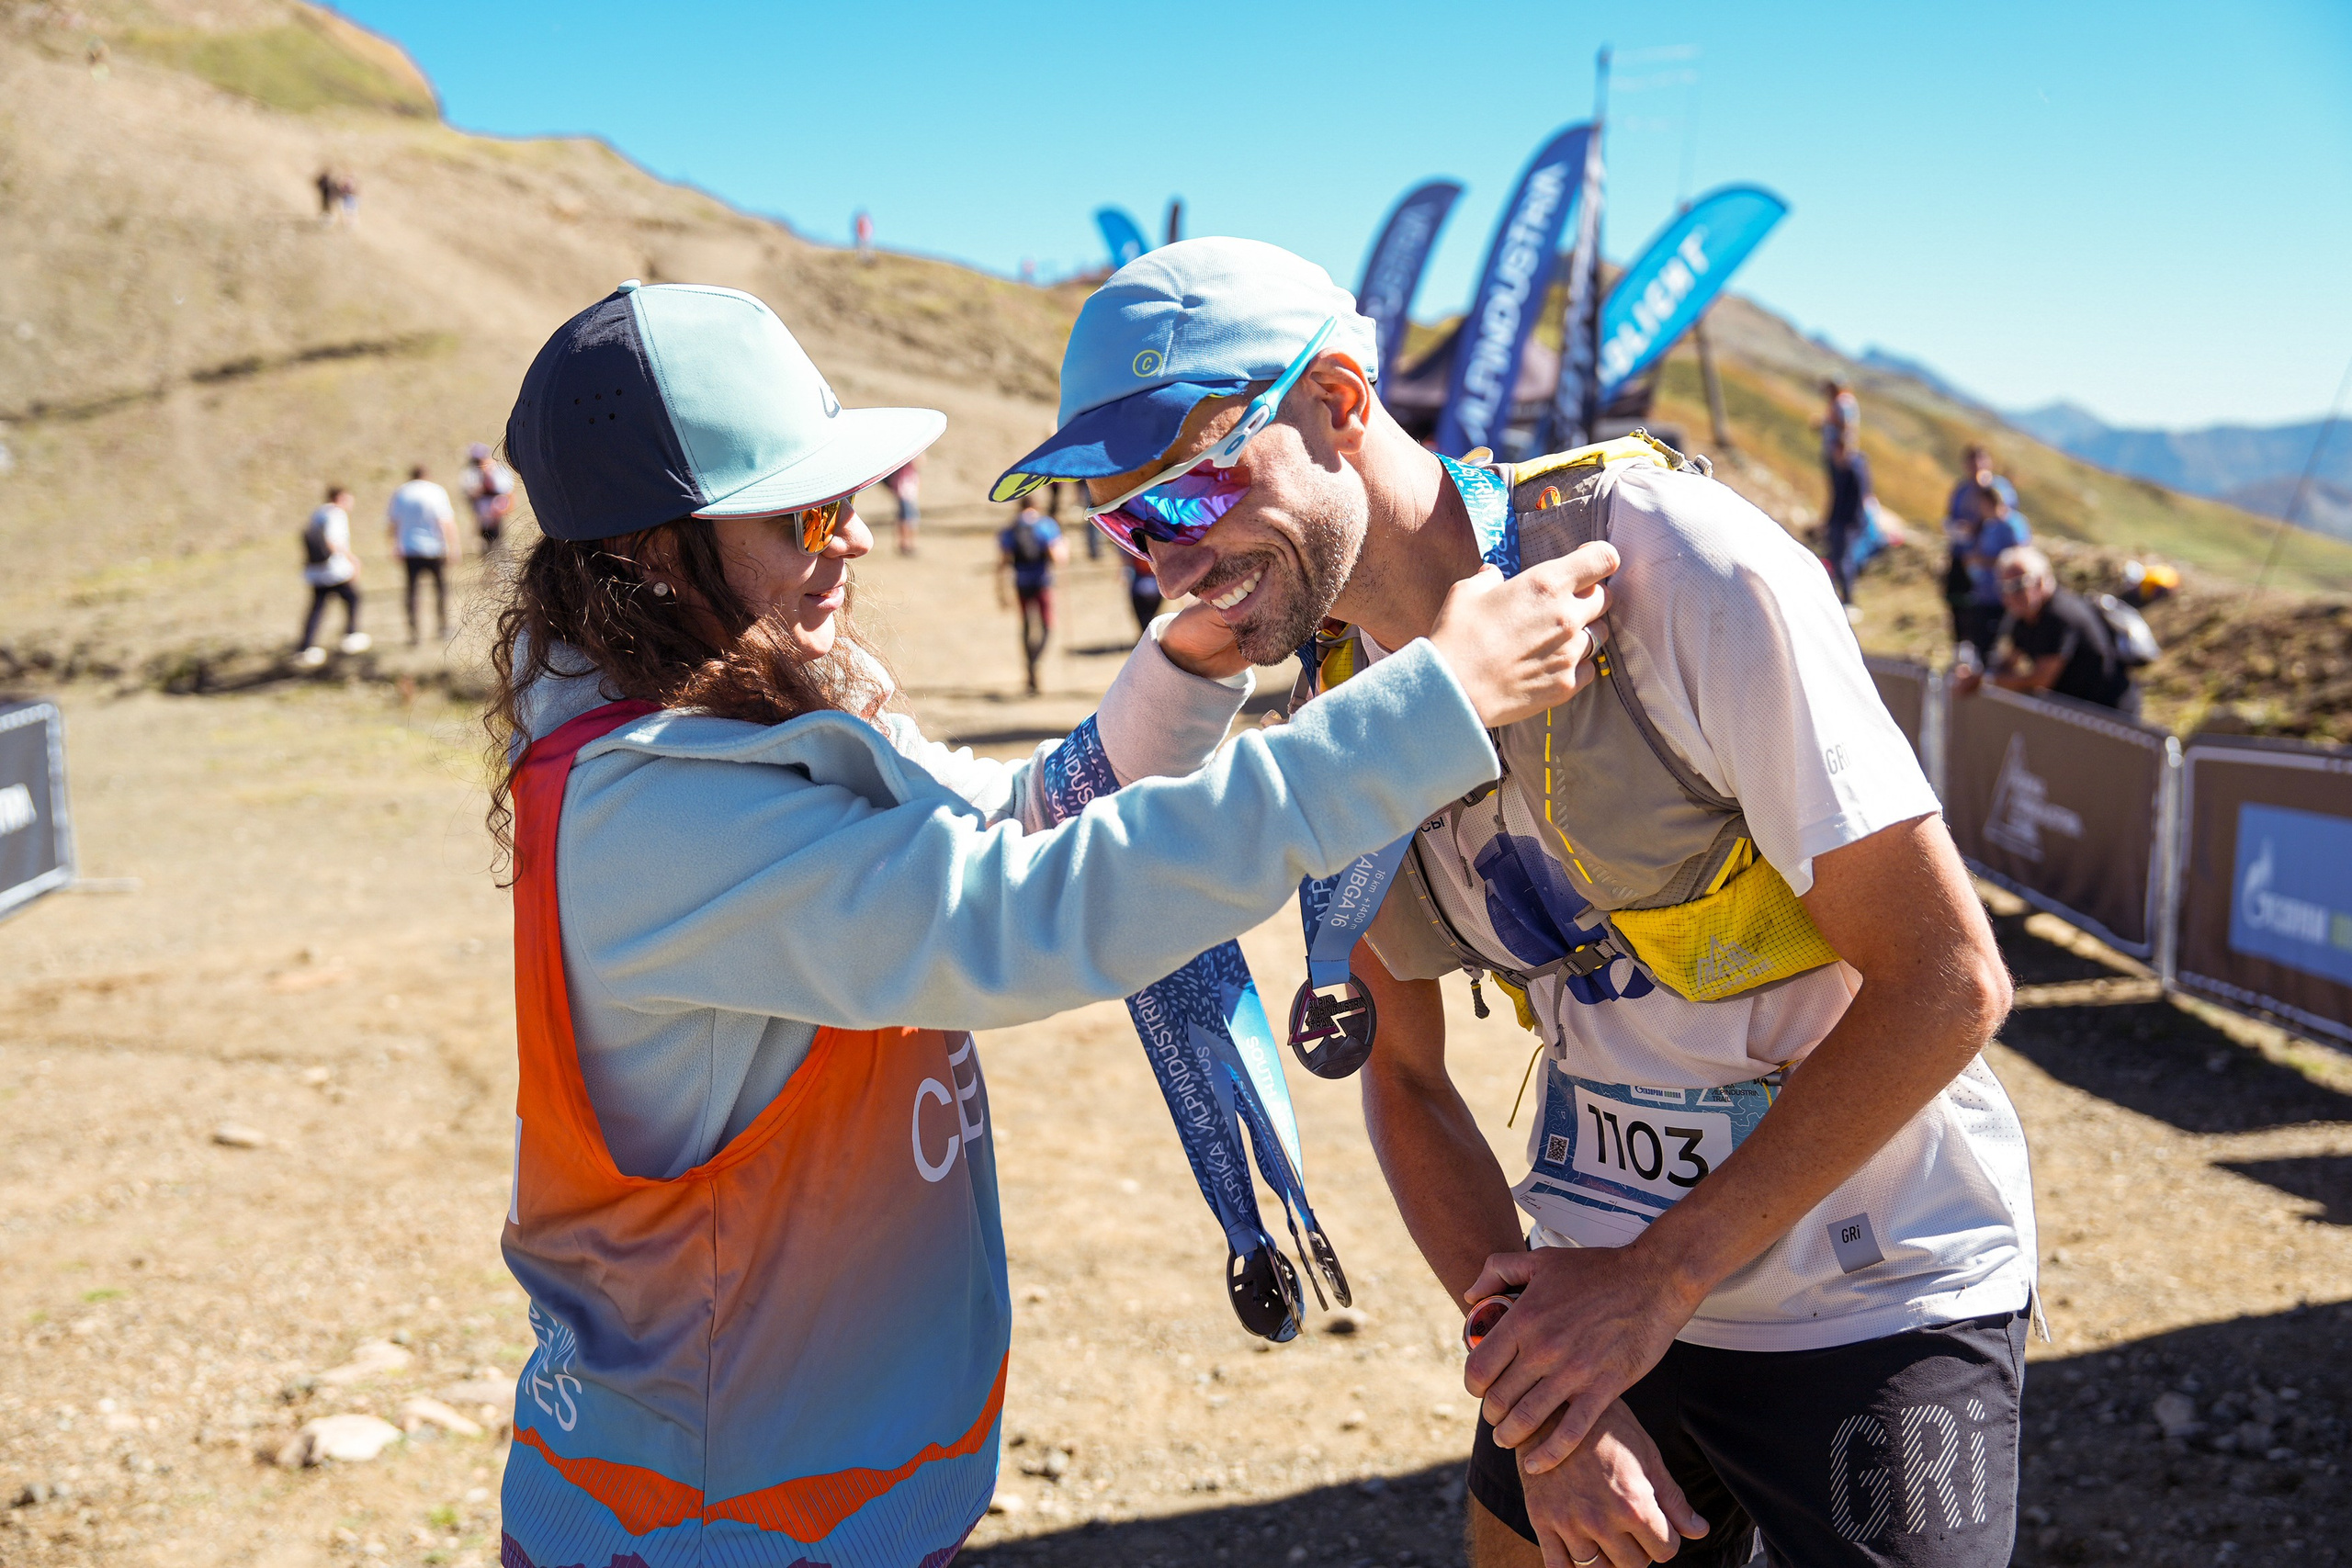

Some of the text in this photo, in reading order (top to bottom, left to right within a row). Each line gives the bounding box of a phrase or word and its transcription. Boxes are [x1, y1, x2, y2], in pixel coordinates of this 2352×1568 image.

[1330, 854, 1374, 928] AIBGA 16
[1368, 880, 1381, 893] km
[1374, 869, 1385, 881] 16
[1246, 1035, 1277, 1098] SOUTH
[1210, 1140, 1249, 1214] ALPIKA
[1588, 1103, 1709, 1188] 1103
[1841, 1224, 1861, 1244] GRi
[1830, 1398, 1986, 1541] GRi
